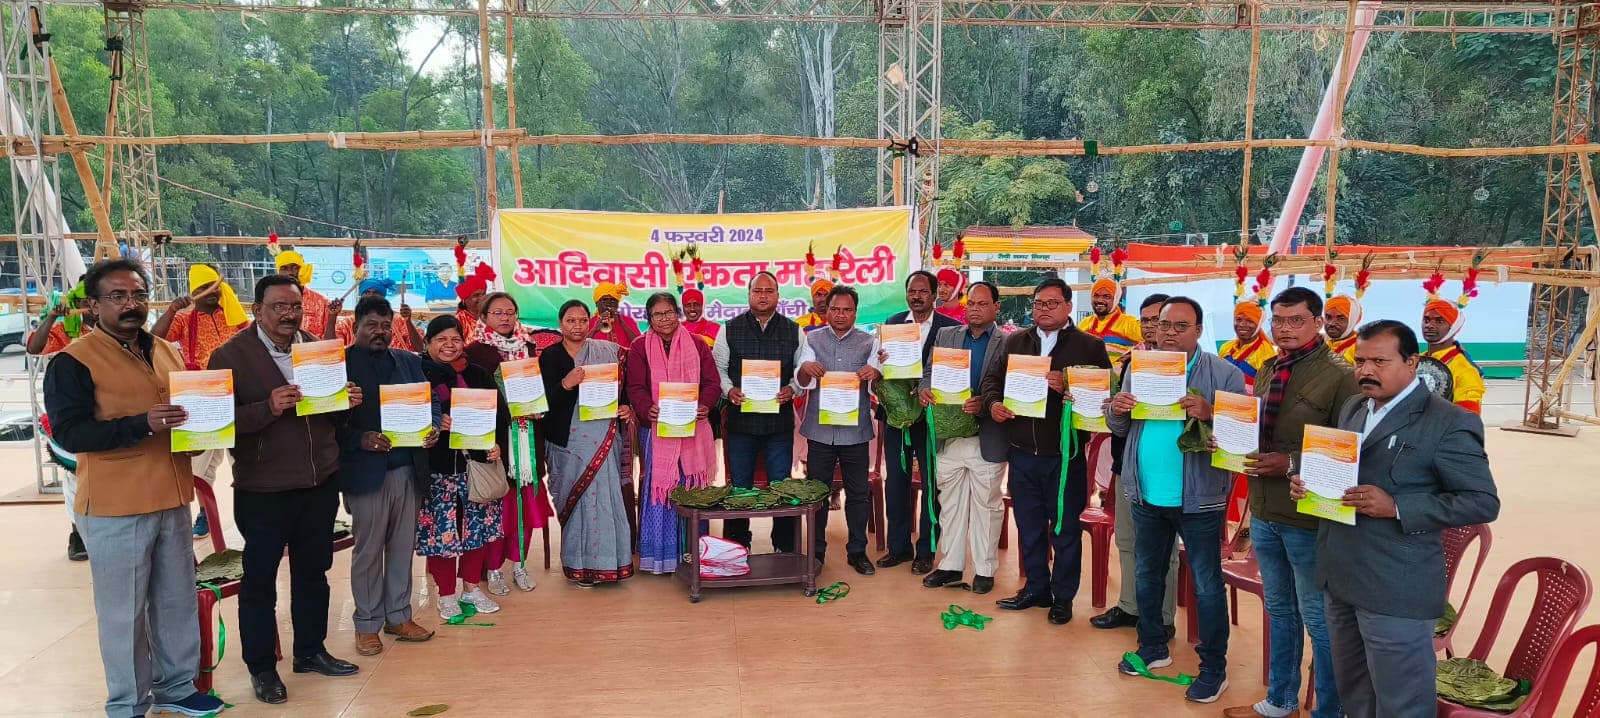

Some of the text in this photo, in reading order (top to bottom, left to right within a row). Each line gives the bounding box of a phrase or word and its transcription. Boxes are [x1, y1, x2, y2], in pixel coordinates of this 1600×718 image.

[651, 226, 763, 243] 4 फरवरी 2024
[514, 251, 669, 288] आदिवासी
[777, 299, 808, 316] ाँची
